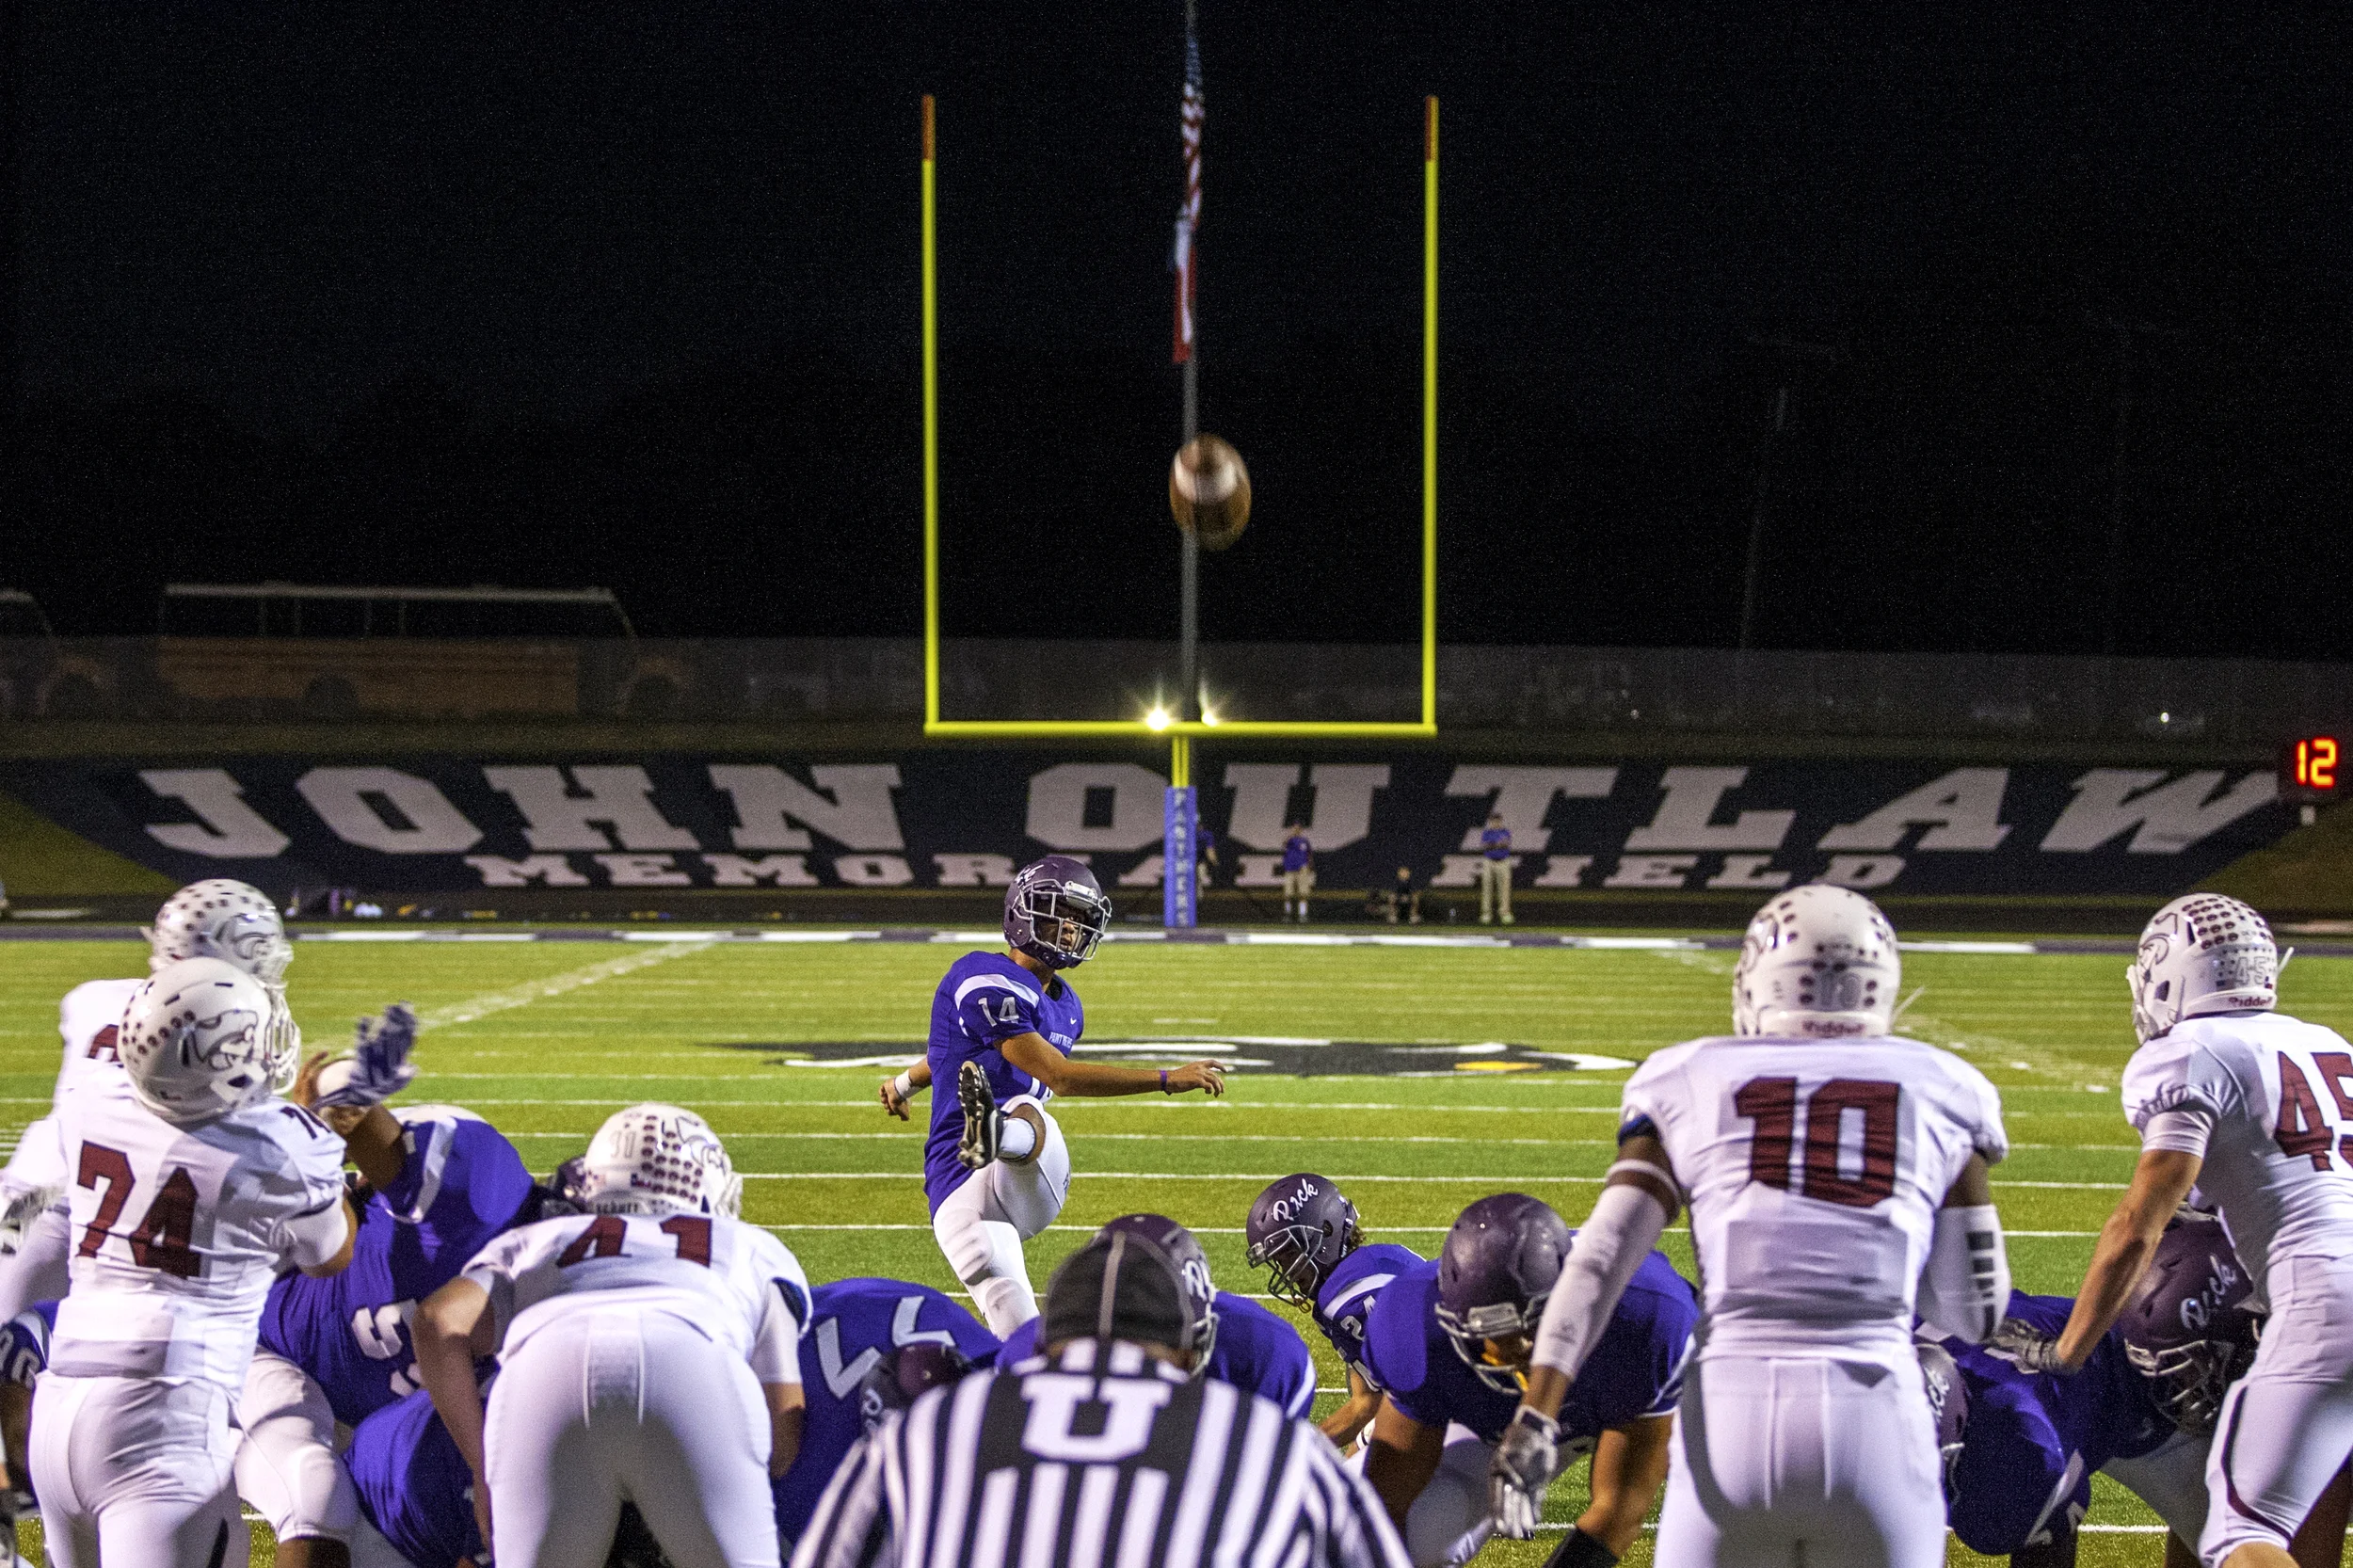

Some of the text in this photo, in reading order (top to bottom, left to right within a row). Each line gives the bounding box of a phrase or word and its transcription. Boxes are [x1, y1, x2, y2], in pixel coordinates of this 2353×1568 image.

[2297, 738, 2337, 788] 12
[139, 763, 2279, 857] JOHN OUTLAW
[464, 855, 1315, 887] MEMORAL
[1432, 855, 1906, 887] FIELD
[978, 996, 1020, 1028] 14
[1734, 1076, 1902, 1208] 10
[2274, 1050, 2353, 1173] 45
[75, 1139, 201, 1278] 74
[556, 1214, 712, 1268] 41
[1019, 1374, 1174, 1462] U
